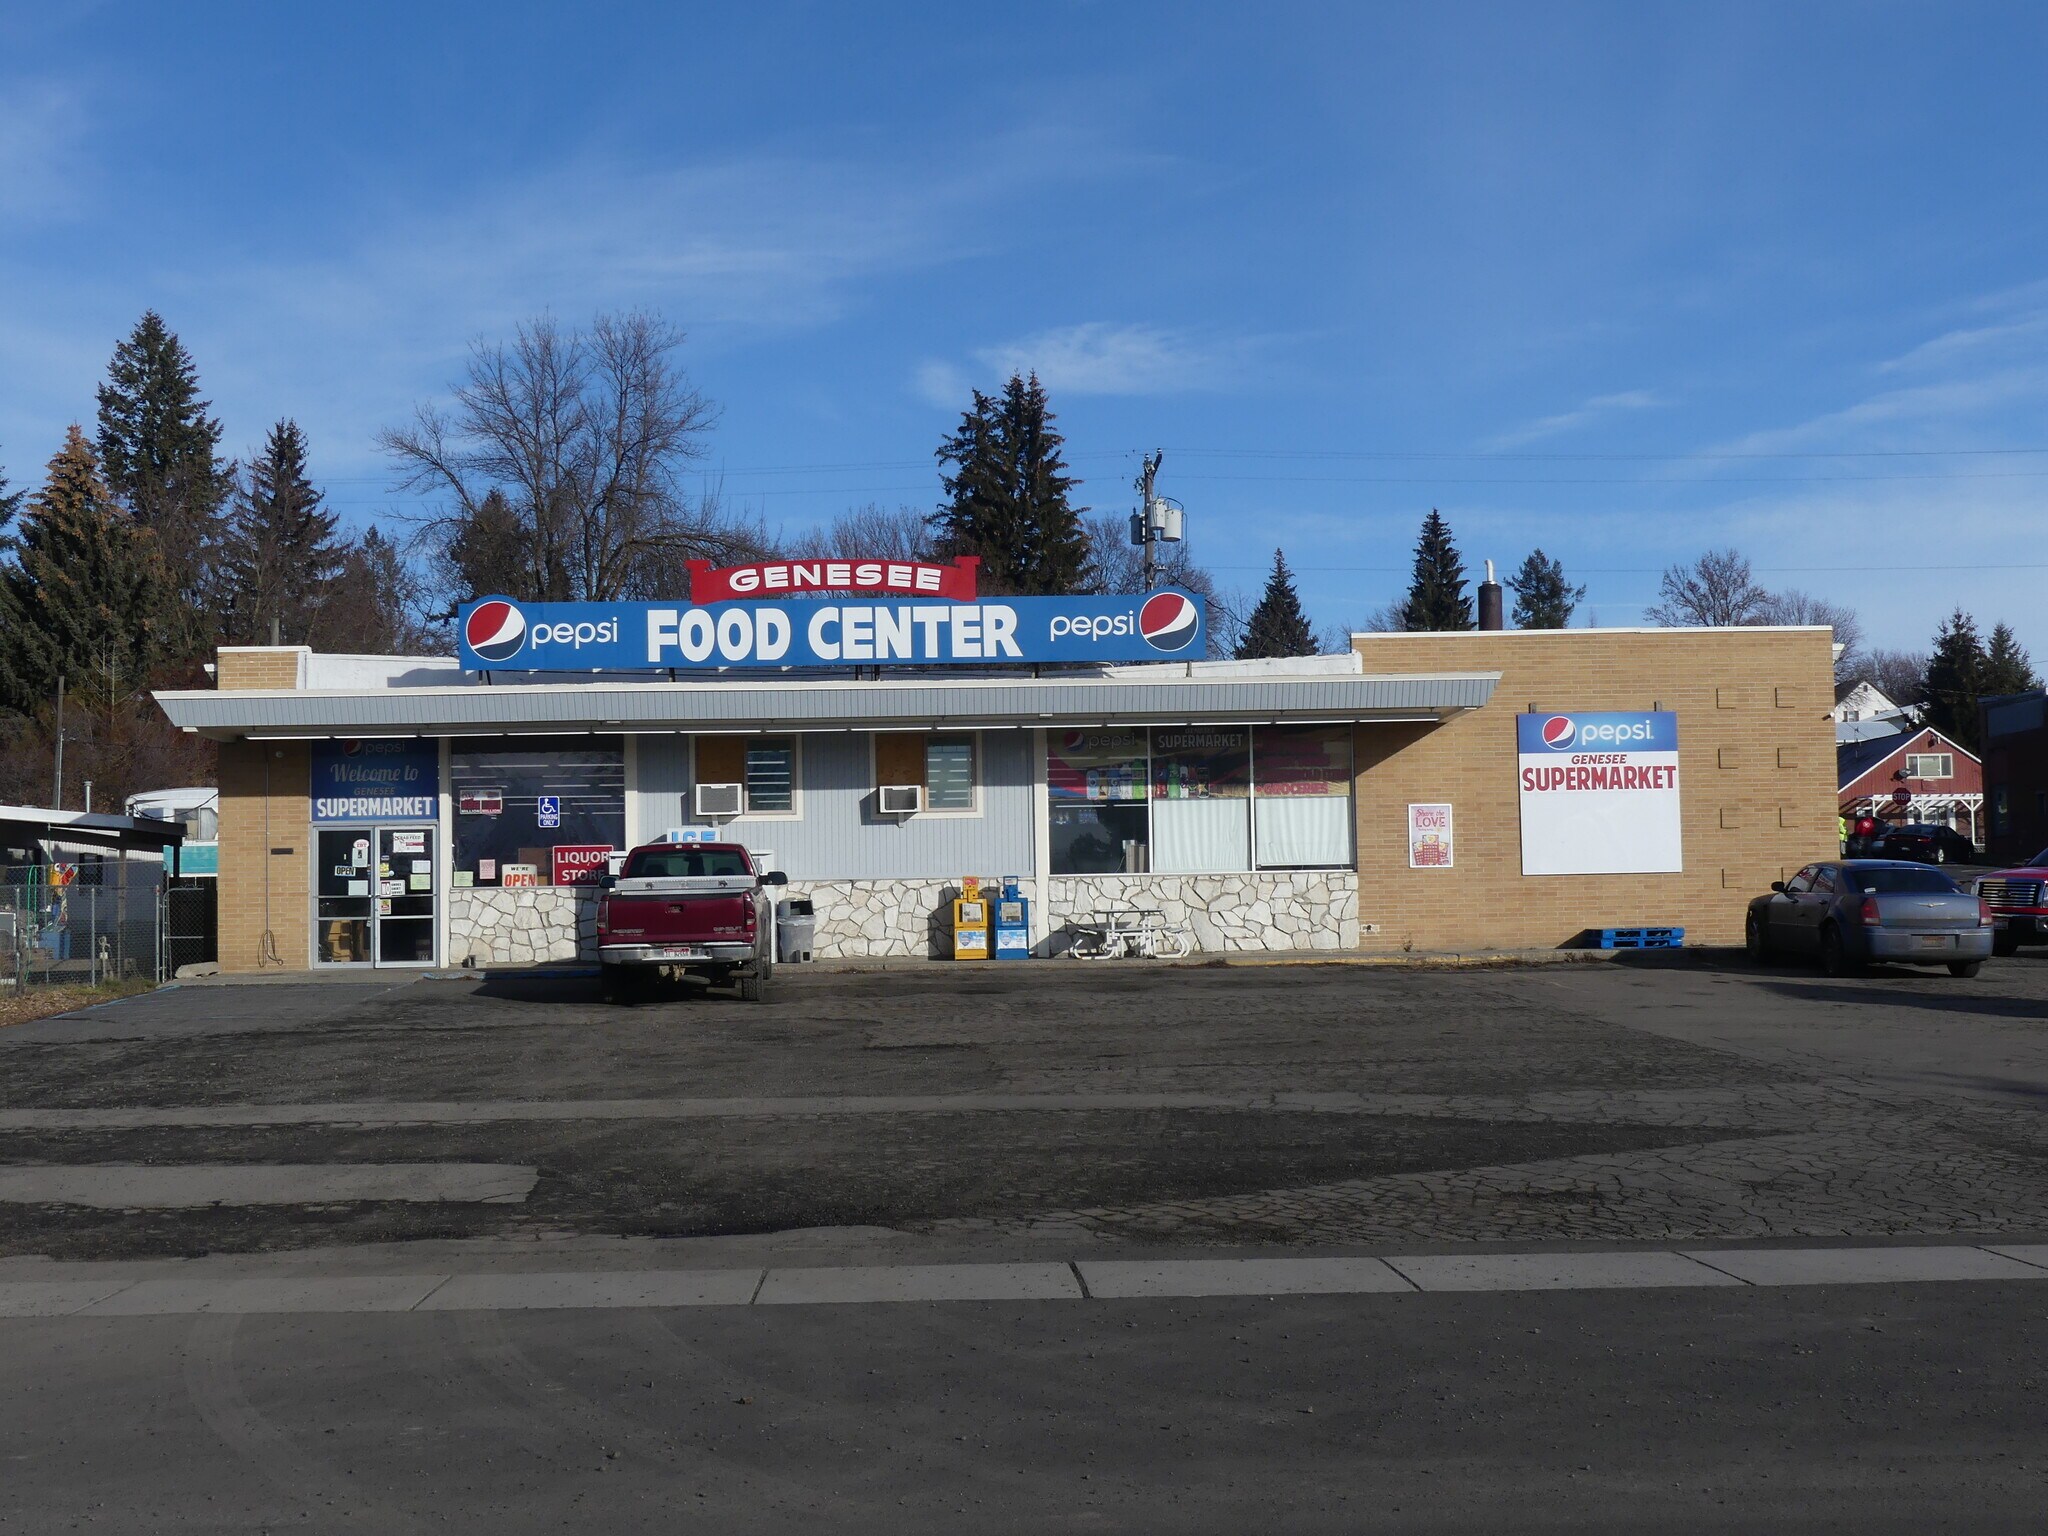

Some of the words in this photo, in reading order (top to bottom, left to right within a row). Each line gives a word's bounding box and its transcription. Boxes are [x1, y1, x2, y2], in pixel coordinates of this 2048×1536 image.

[729, 563, 942, 592] GENESEE
[531, 616, 618, 650] pepsi
[647, 607, 792, 662] FOOD
[807, 604, 1024, 660] CENTER
[1049, 610, 1134, 642] pepsi
[1088, 732, 1136, 749] pepsi
[1581, 719, 1654, 746] pepsi
[365, 740, 405, 755] pepsi
[1158, 733, 1243, 749] SUPERMARKET
[1571, 754, 1627, 765] GENESEE
[330, 763, 400, 783] Welcome
[403, 764, 419, 781] to
[1522, 765, 1677, 792] SUPERMARKET
[353, 786, 396, 796] GENESEE
[1893, 792, 1911, 801] STOP
[316, 796, 433, 817] SUPERMARKET
[1415, 816, 1446, 828] LOVE
[557, 851, 609, 864] LIQUOR
[336, 866, 355, 875] OPEN
[504, 873, 536, 888] OPEN
